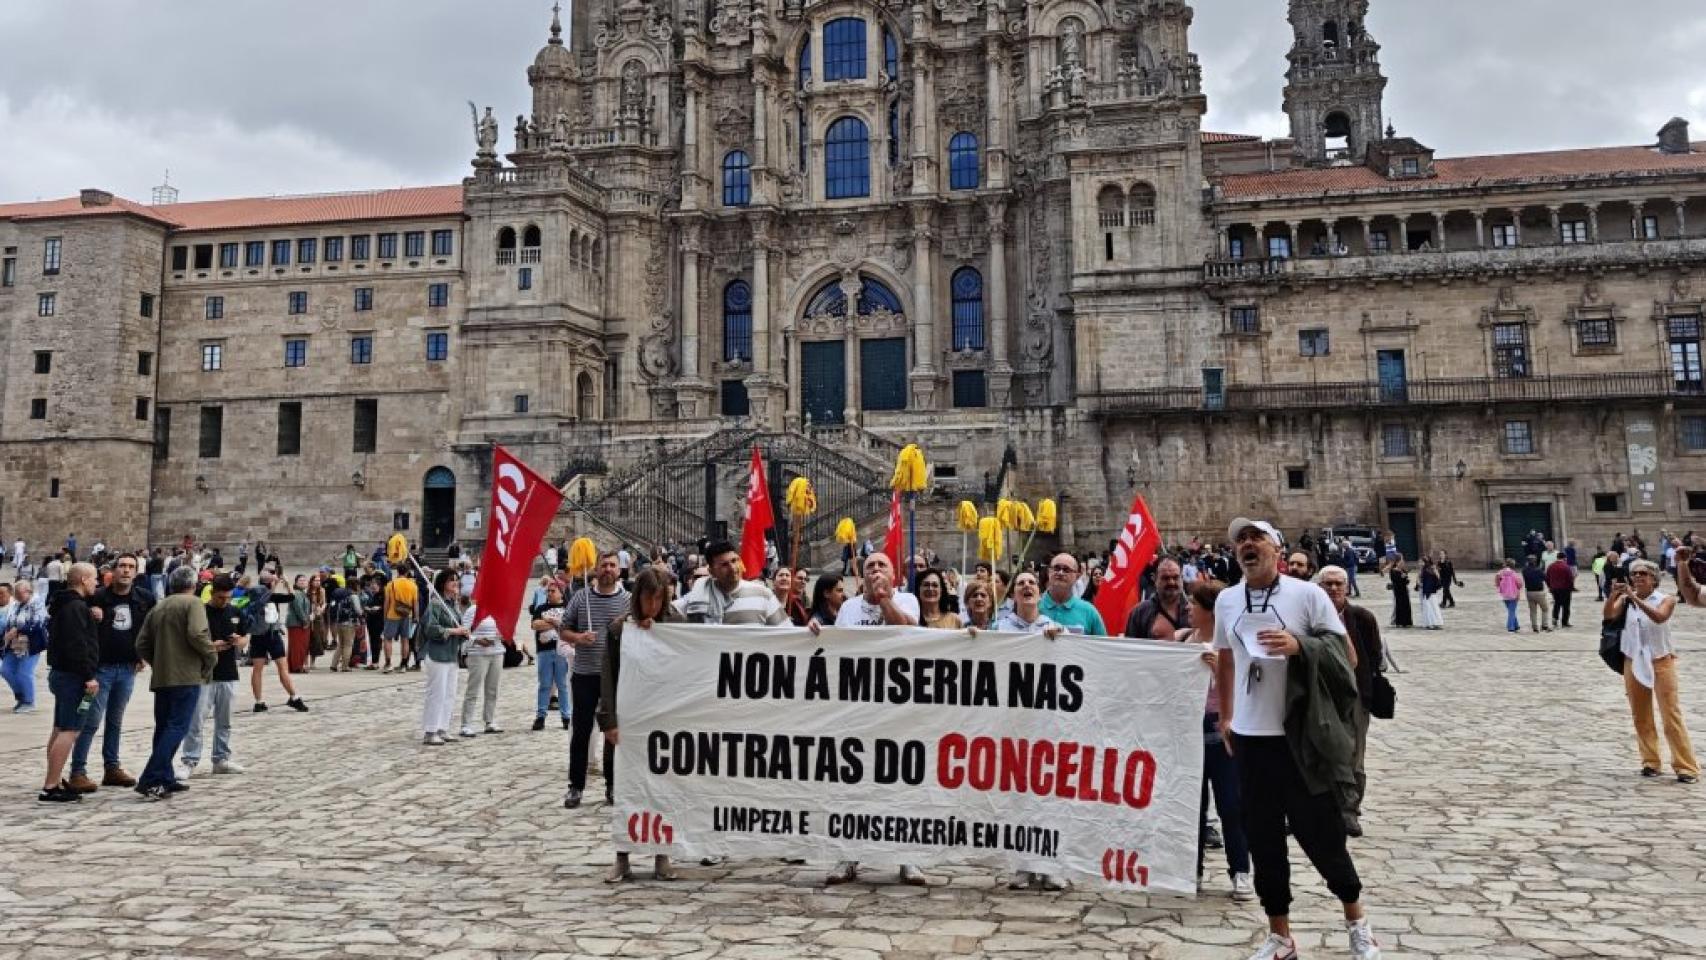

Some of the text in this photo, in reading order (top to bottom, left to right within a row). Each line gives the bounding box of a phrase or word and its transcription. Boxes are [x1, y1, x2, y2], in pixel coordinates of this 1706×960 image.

[716, 648, 1084, 713] NON Á MISERIA NAS
[647, 729, 1157, 810] CONTRATAS DO CONCELLO
[627, 812, 674, 844] CIG
[713, 805, 1060, 859] LIMPEZA E CONSERXERÍA EN LOITA!
[1102, 848, 1149, 886] CIG
